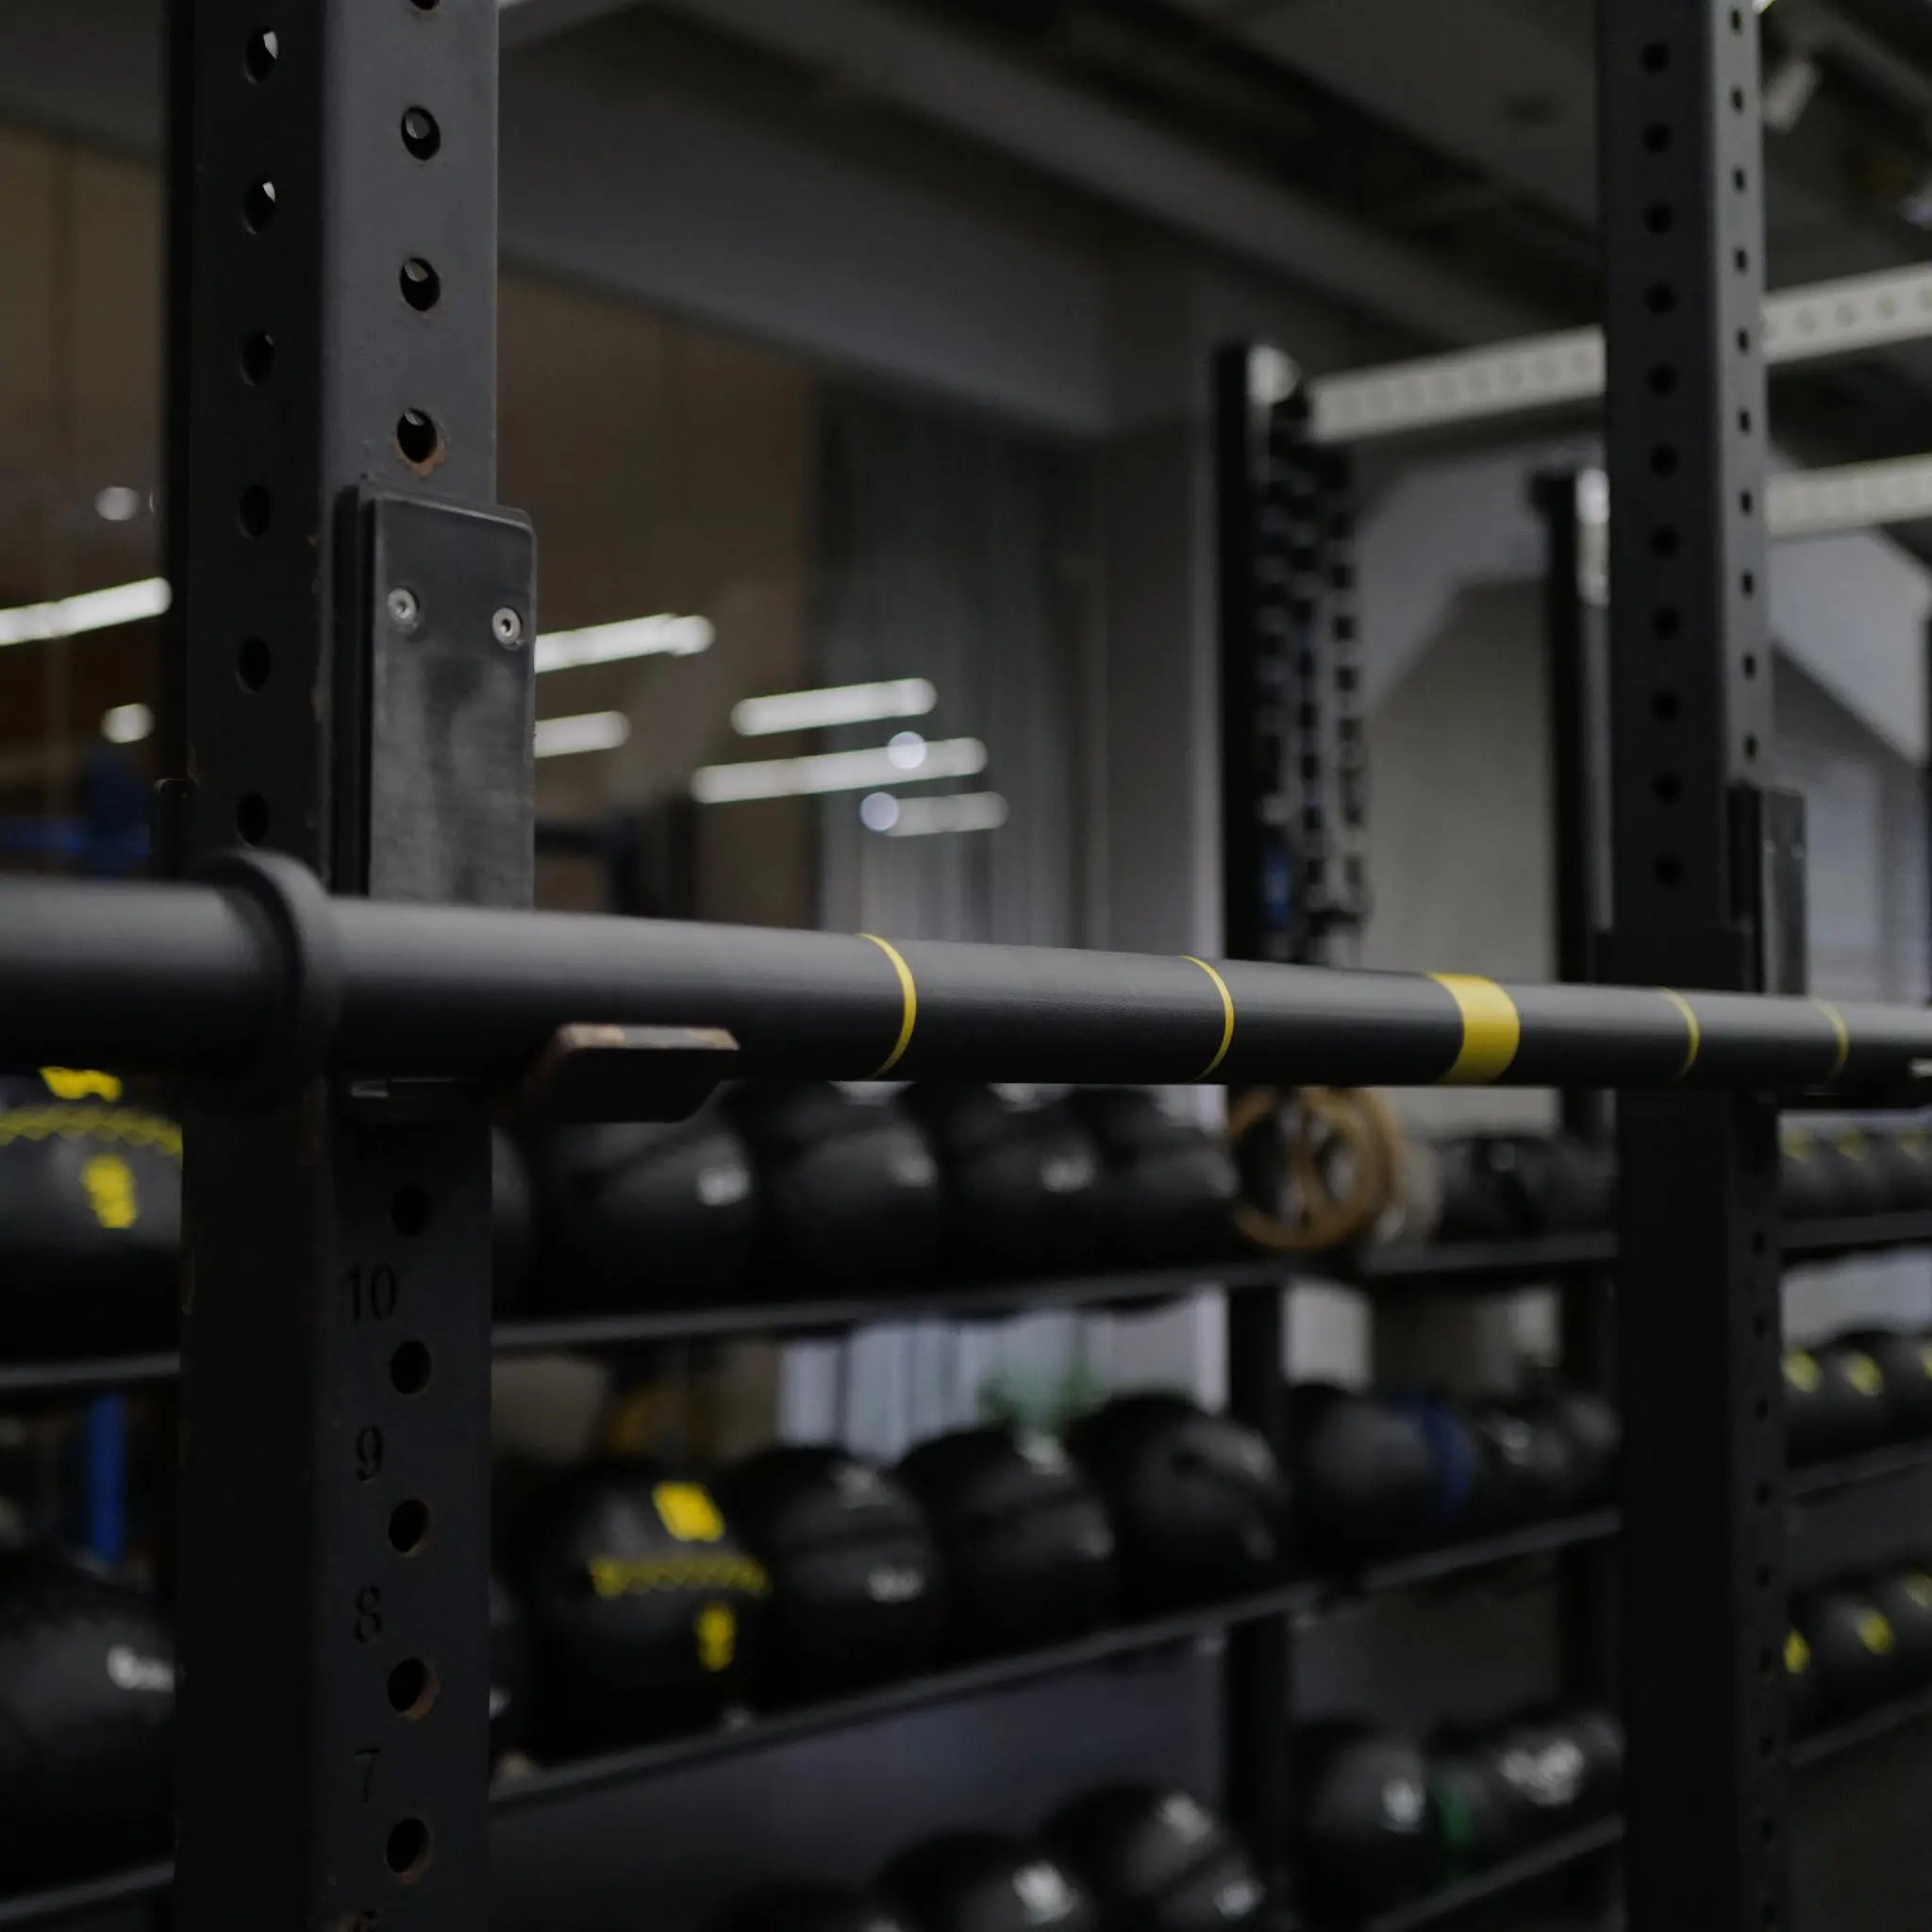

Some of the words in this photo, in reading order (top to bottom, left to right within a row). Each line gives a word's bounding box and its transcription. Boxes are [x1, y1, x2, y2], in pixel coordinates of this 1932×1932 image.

[347, 1260, 397, 1321] 10
[356, 1424, 384, 1481] 9
[354, 1585, 381, 1643] 8
[354, 1747, 381, 1804] 7
